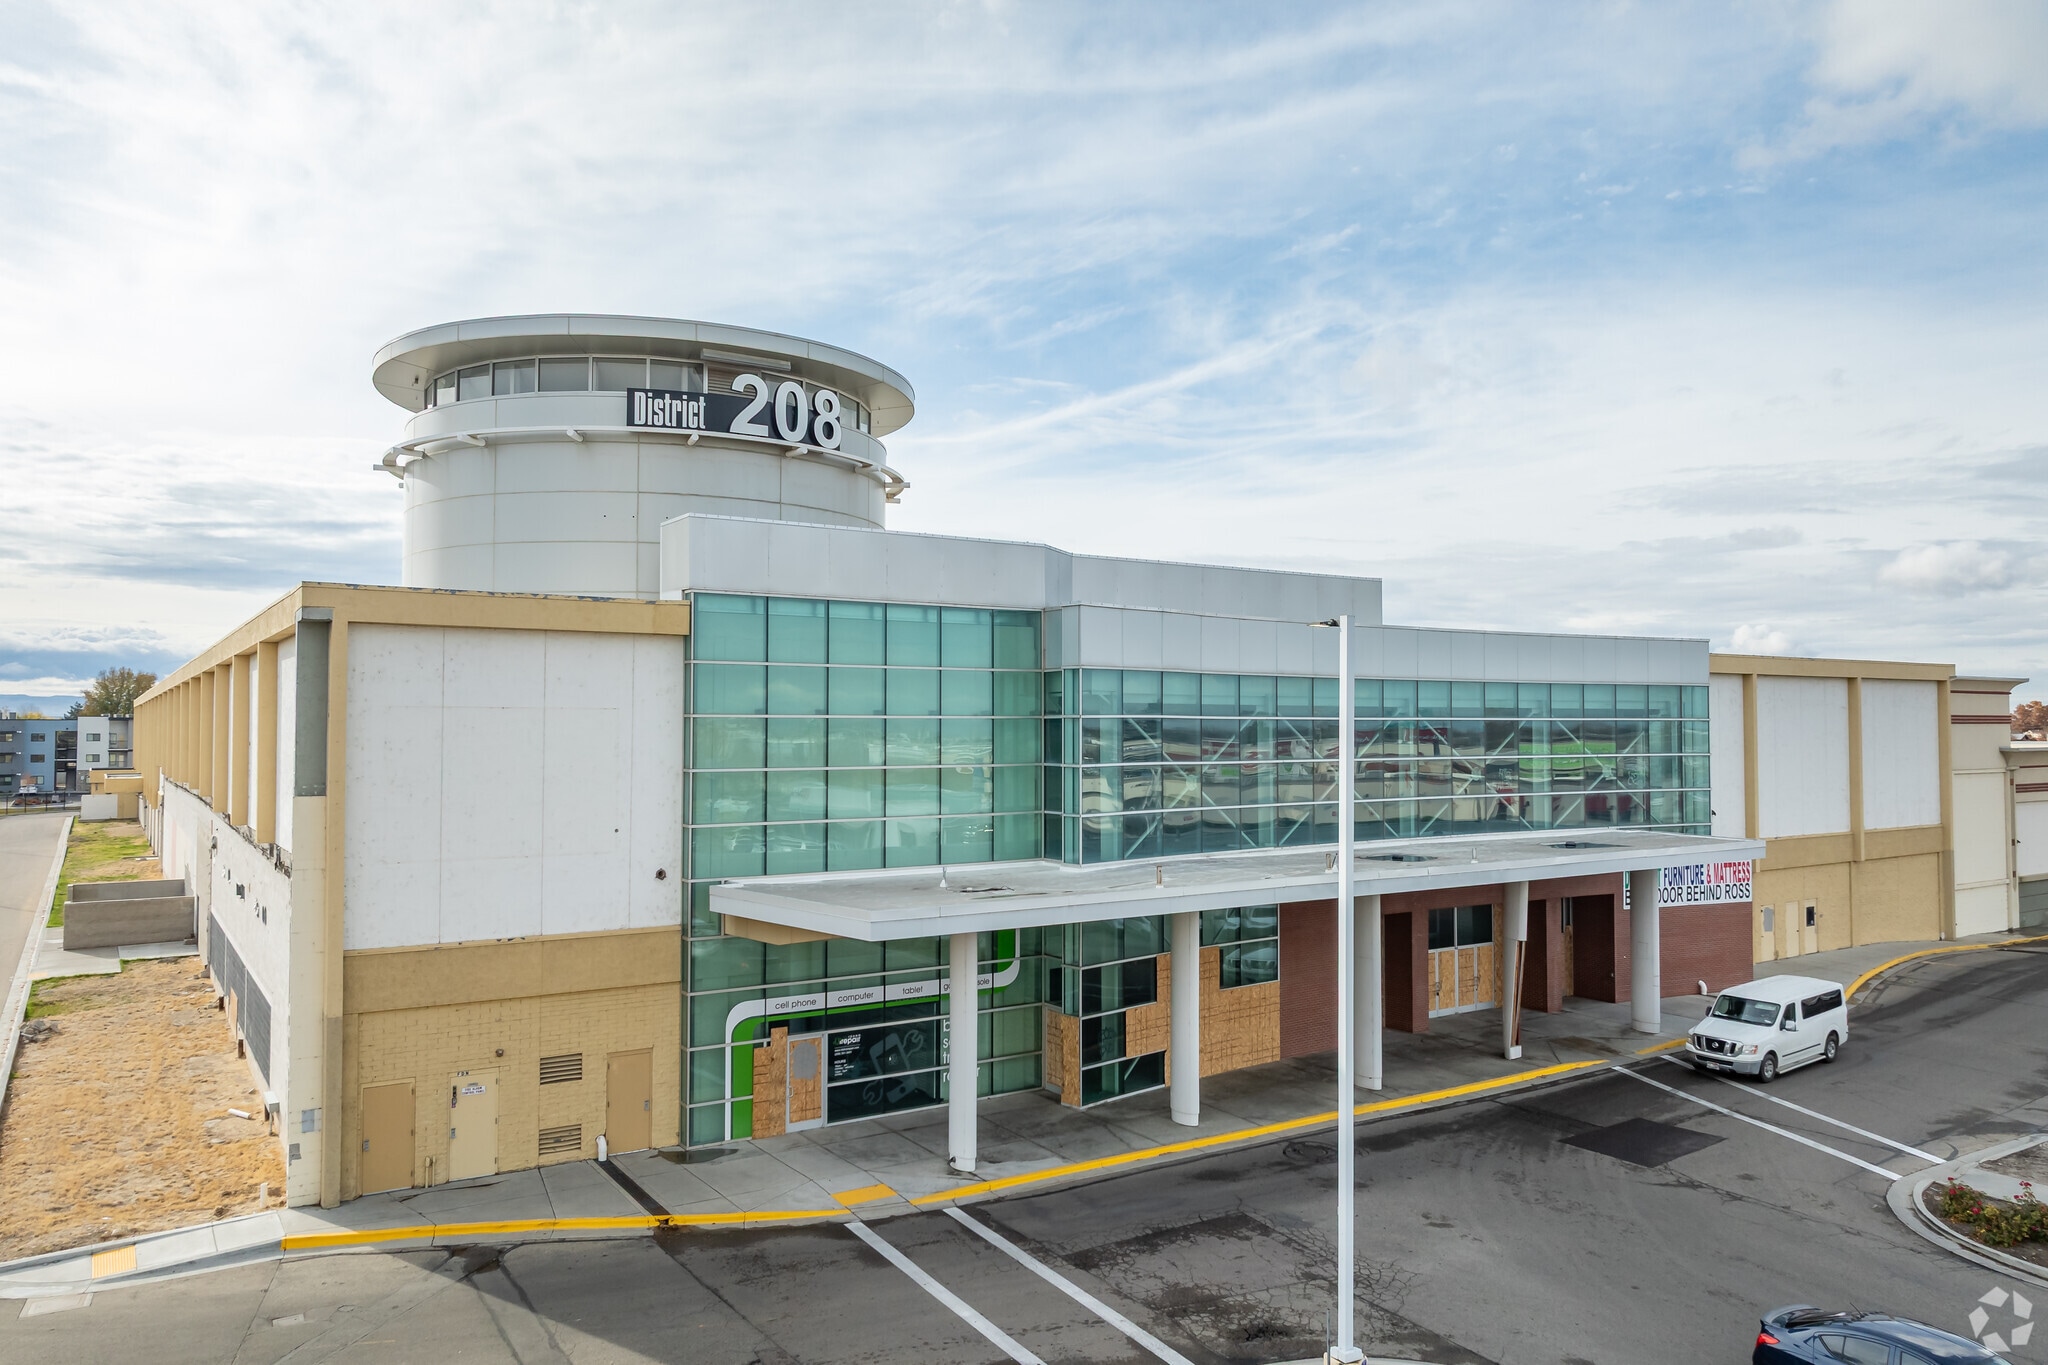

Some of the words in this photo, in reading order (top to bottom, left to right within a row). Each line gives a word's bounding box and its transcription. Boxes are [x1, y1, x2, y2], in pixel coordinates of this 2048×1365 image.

[634, 391, 706, 430] District
[729, 373, 842, 450] 208
[1663, 863, 1705, 887] FURNITURE
[1706, 863, 1712, 885] &
[1713, 861, 1751, 884] MATTRESS
[1686, 884, 1722, 902] BEHIND
[1725, 882, 1751, 899] ROSS
[837, 991, 874, 1003] computer
[902, 985, 923, 995] tablet
[774, 1000, 790, 1010] cell
[791, 998, 817, 1009] phone
